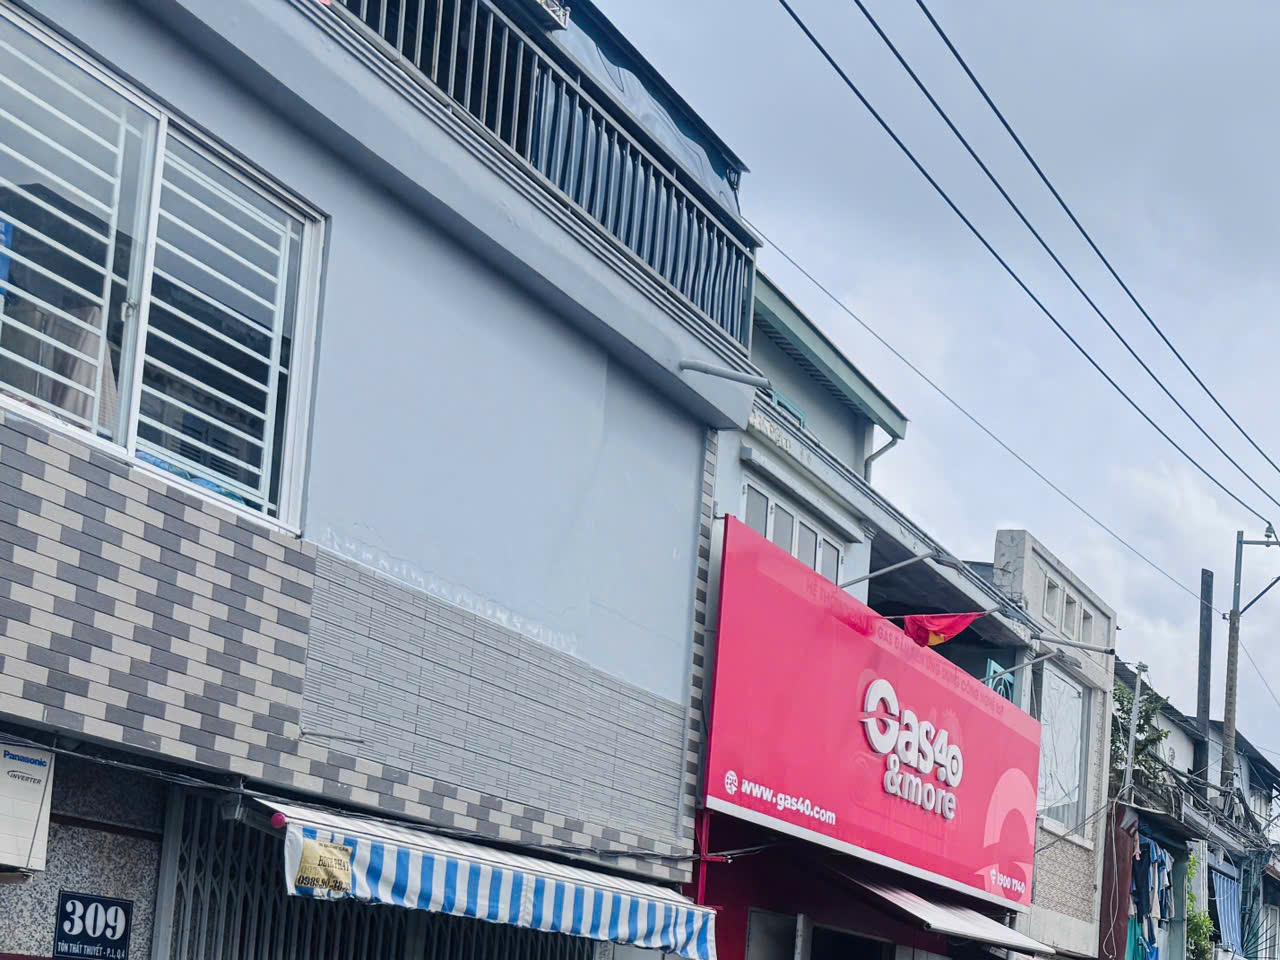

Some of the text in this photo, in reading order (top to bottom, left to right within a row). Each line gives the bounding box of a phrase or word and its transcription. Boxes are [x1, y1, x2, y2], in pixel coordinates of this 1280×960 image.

[3, 750, 47, 767] Panasonic
[10, 773, 42, 785] INVERTER
[884, 753, 957, 820] &more
[741, 779, 837, 825] www.gas40.com
[62, 899, 126, 940] 309
[57, 940, 69, 953] TÔN
